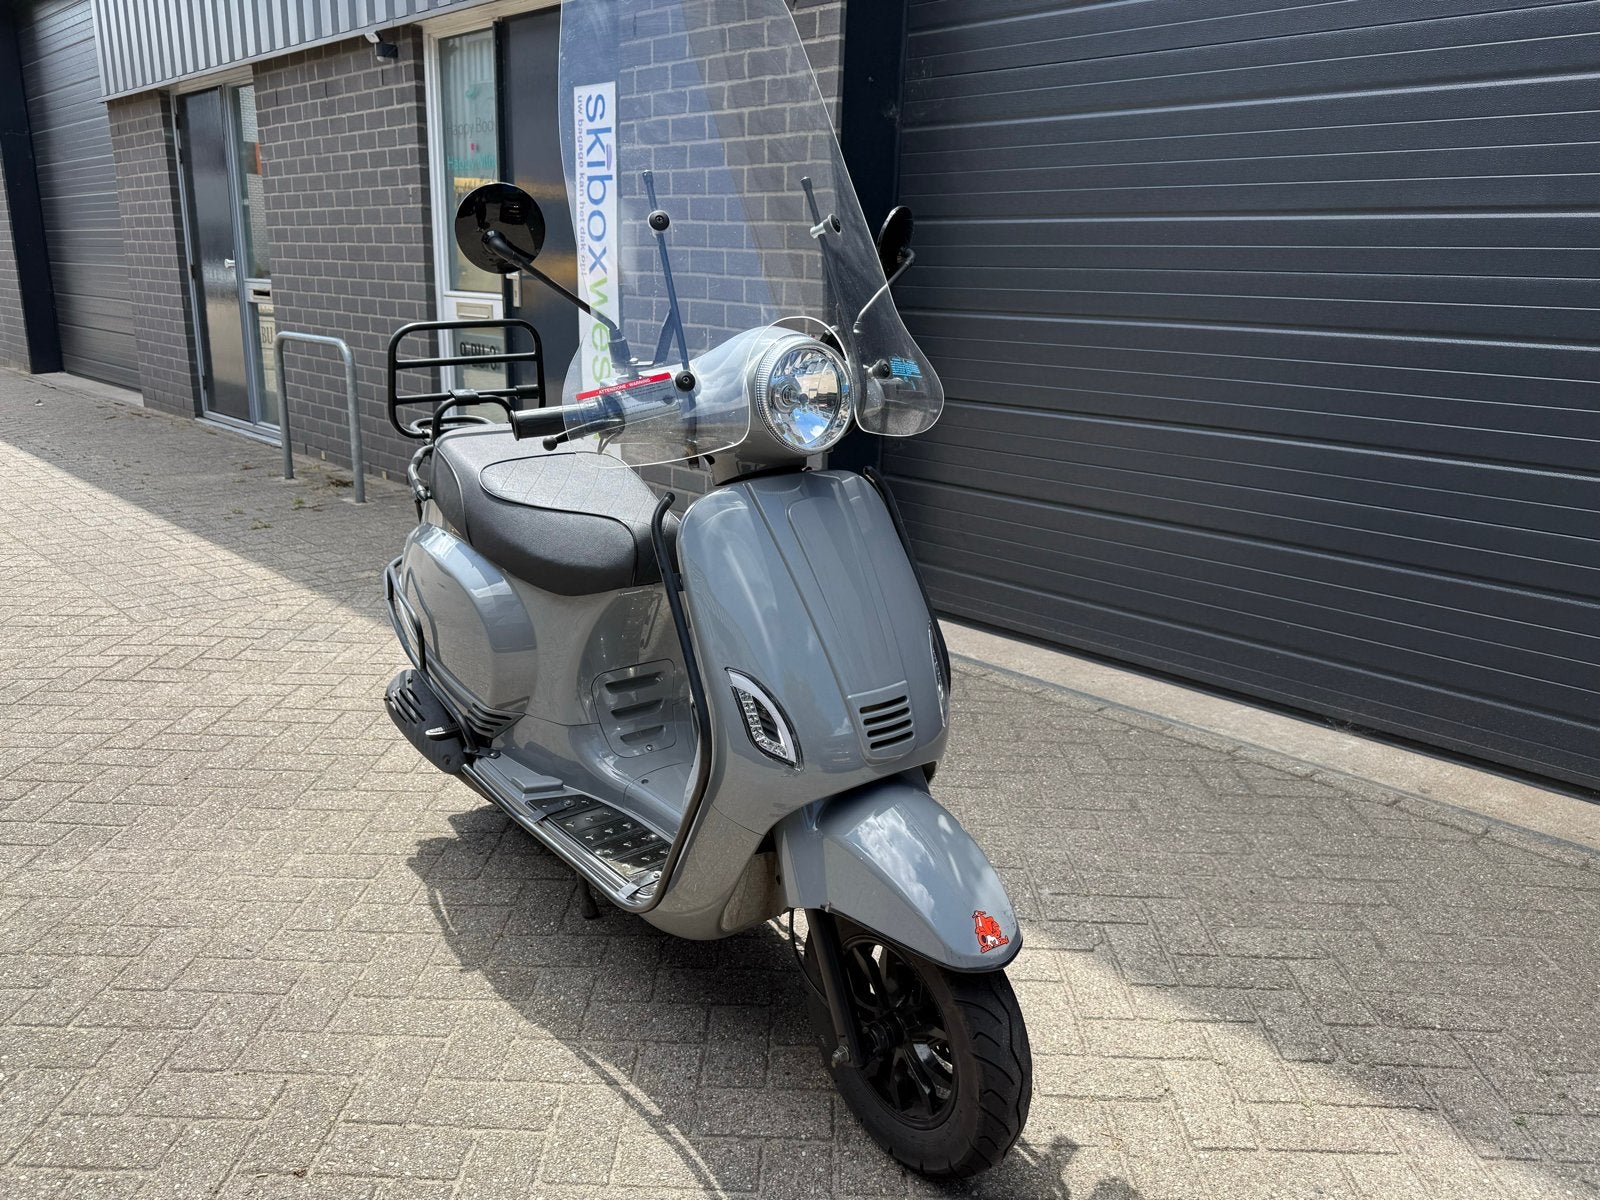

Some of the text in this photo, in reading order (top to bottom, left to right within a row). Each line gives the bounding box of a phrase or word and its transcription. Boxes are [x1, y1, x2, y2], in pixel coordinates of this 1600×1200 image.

[577, 95, 583, 115] uw
[446, 120, 475, 139] Happy
[576, 118, 584, 168] bagage
[579, 226, 587, 250] dak
